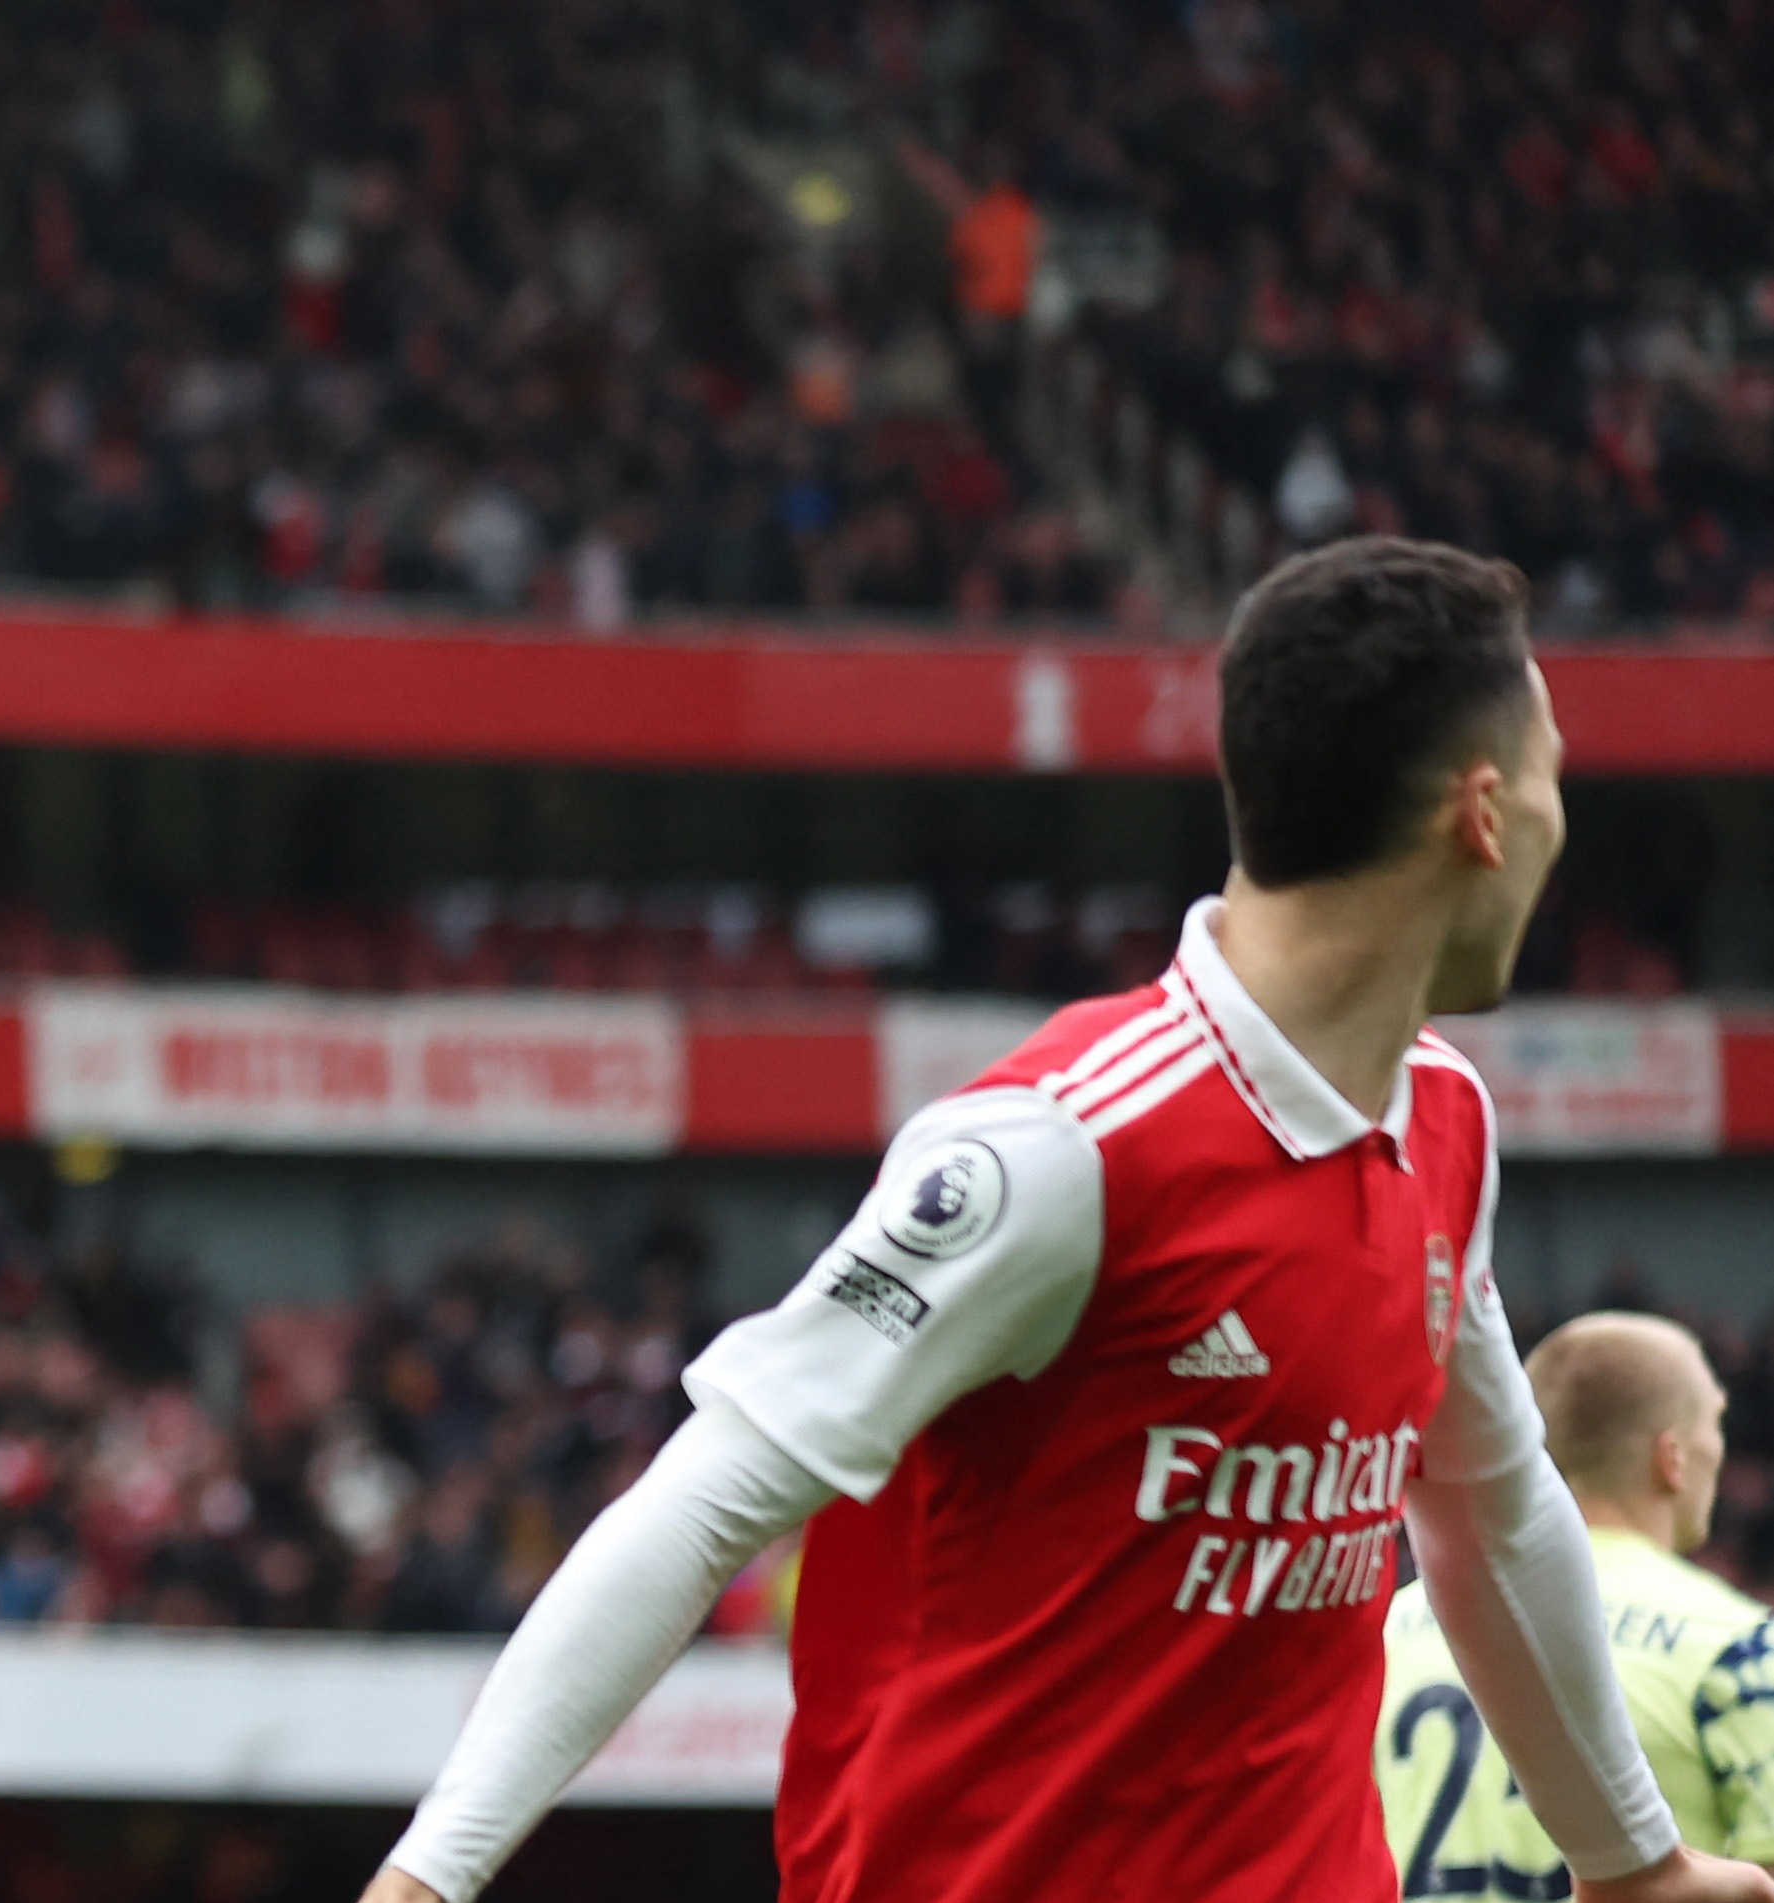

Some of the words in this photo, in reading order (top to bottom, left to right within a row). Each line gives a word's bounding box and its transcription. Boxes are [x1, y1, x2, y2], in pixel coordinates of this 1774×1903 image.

[1168, 1354, 1270, 1378] adidas
[1135, 1417, 1420, 1524] Emirat
[1172, 1534, 1291, 1617] FLY
